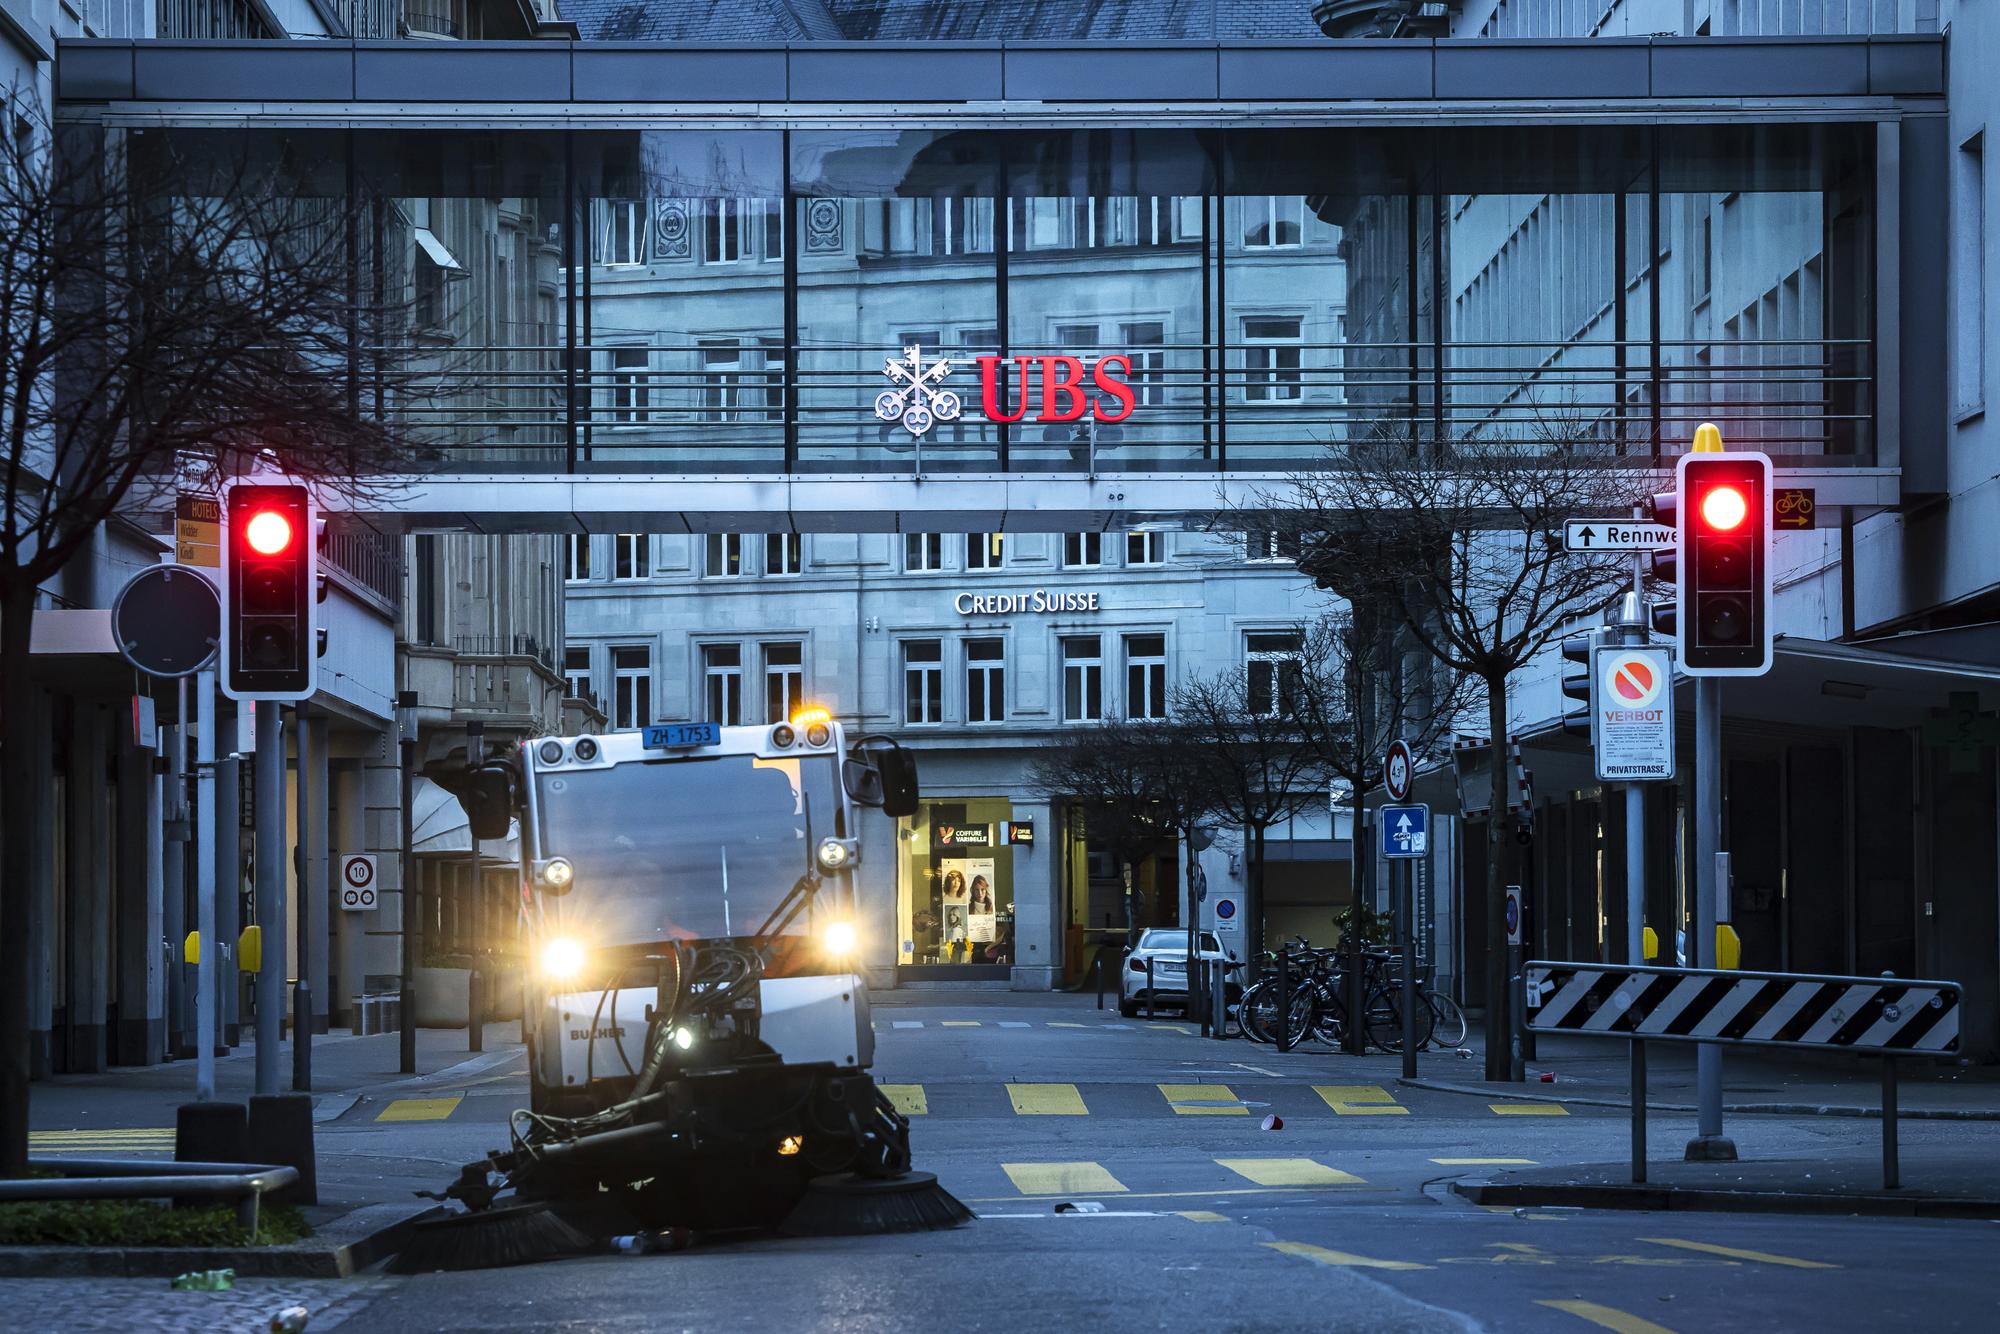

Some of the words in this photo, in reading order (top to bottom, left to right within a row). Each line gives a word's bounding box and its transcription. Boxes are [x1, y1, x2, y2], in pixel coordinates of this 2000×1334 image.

[975, 354, 1136, 423] UBS
[192, 502, 218, 519] HOTELS
[180, 524, 198, 538] Widder
[1607, 527, 1677, 543] Rennwe
[954, 592, 1030, 615] CREDIT
[1032, 589, 1099, 613] SUISSE
[1605, 710, 1664, 722] VERBOT
[1606, 765, 1665, 774] PRIVATSTRASSE
[354, 867, 365, 878] 10
